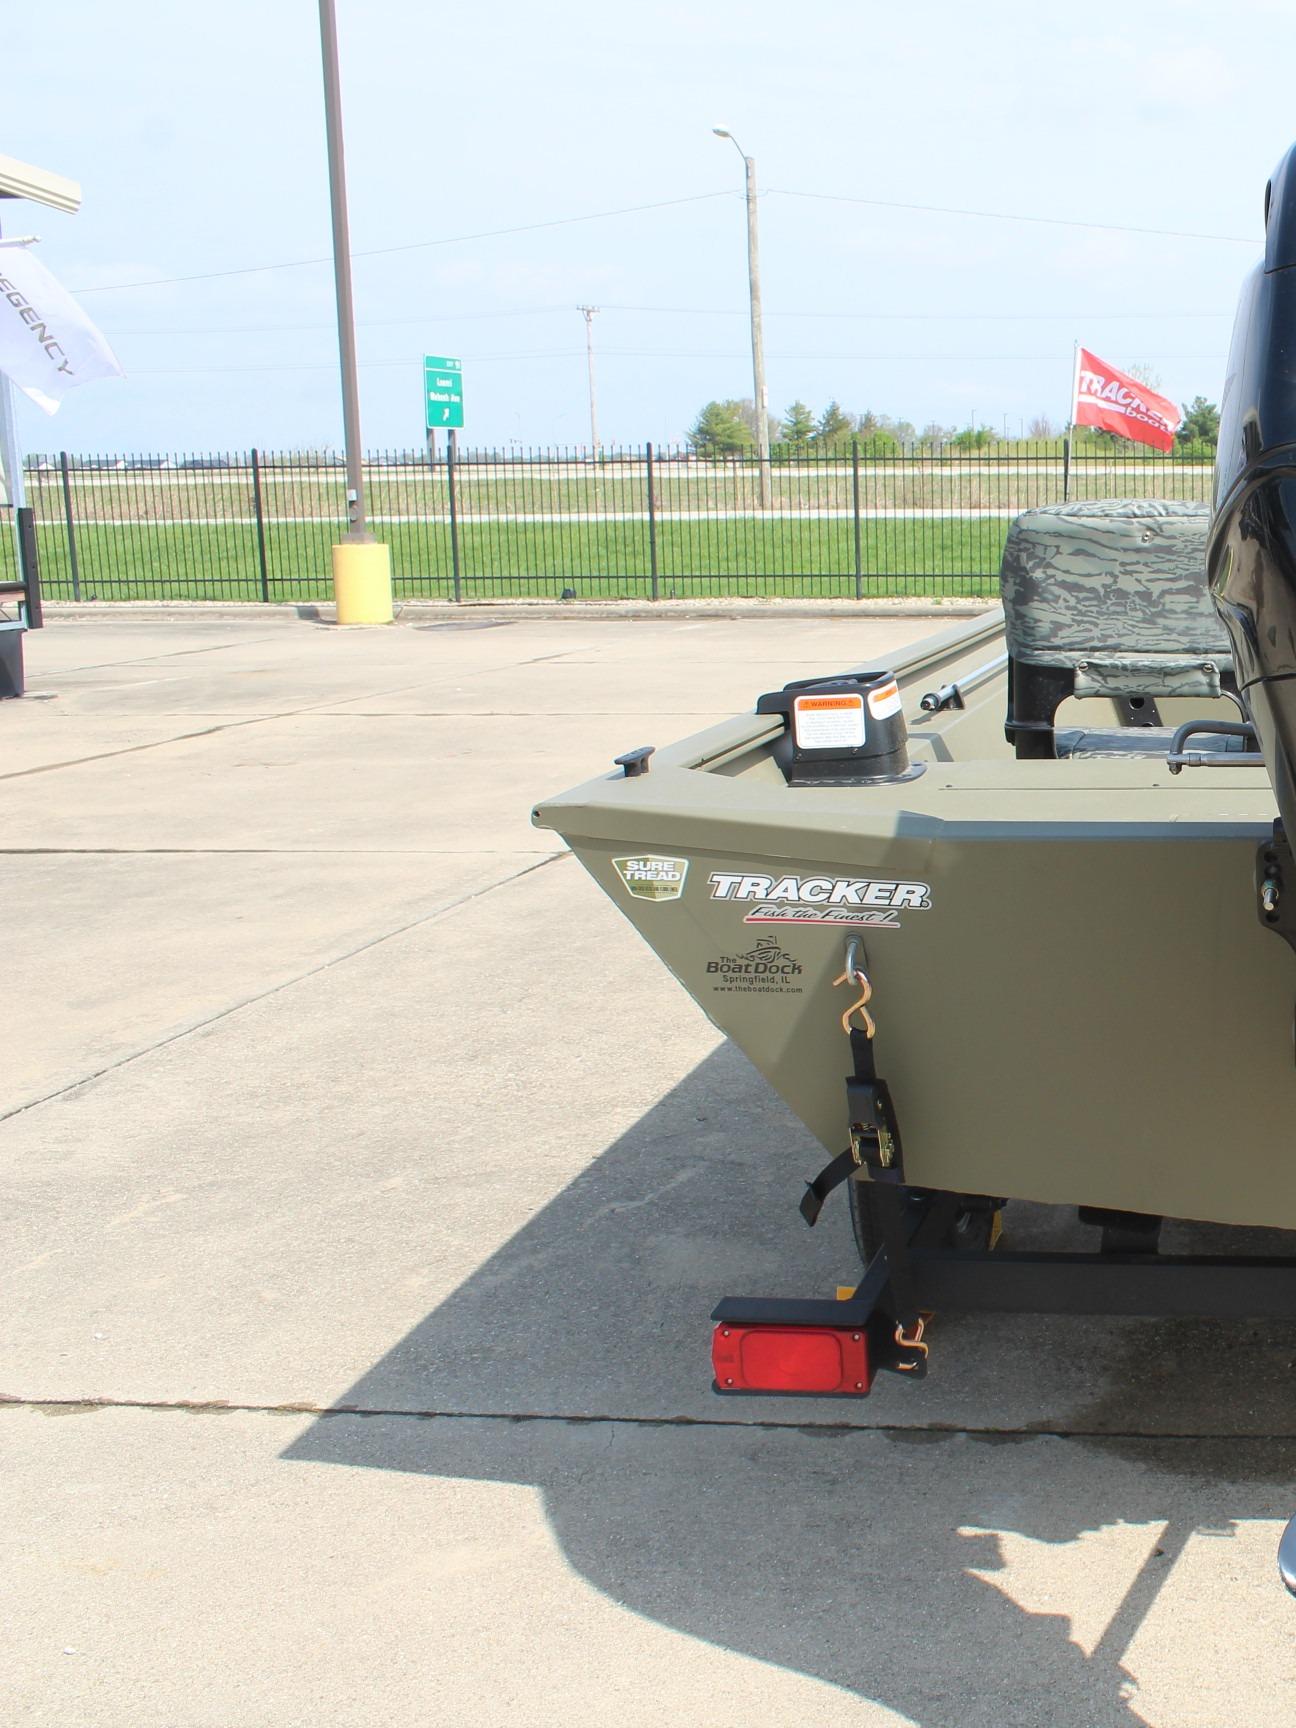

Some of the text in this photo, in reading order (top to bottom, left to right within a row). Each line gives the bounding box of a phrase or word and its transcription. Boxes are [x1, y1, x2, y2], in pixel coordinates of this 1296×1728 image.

[0, 273, 74, 375] EGENCY
[626, 860, 675, 871] SURE
[623, 871, 681, 881] TREAD
[751, 906, 788, 918] Fish
[792, 907, 817, 919] the
[719, 956, 737, 964] The
[722, 975, 791, 985] Springfield, IL
[713, 985, 803, 994] www.theboatdock.com
